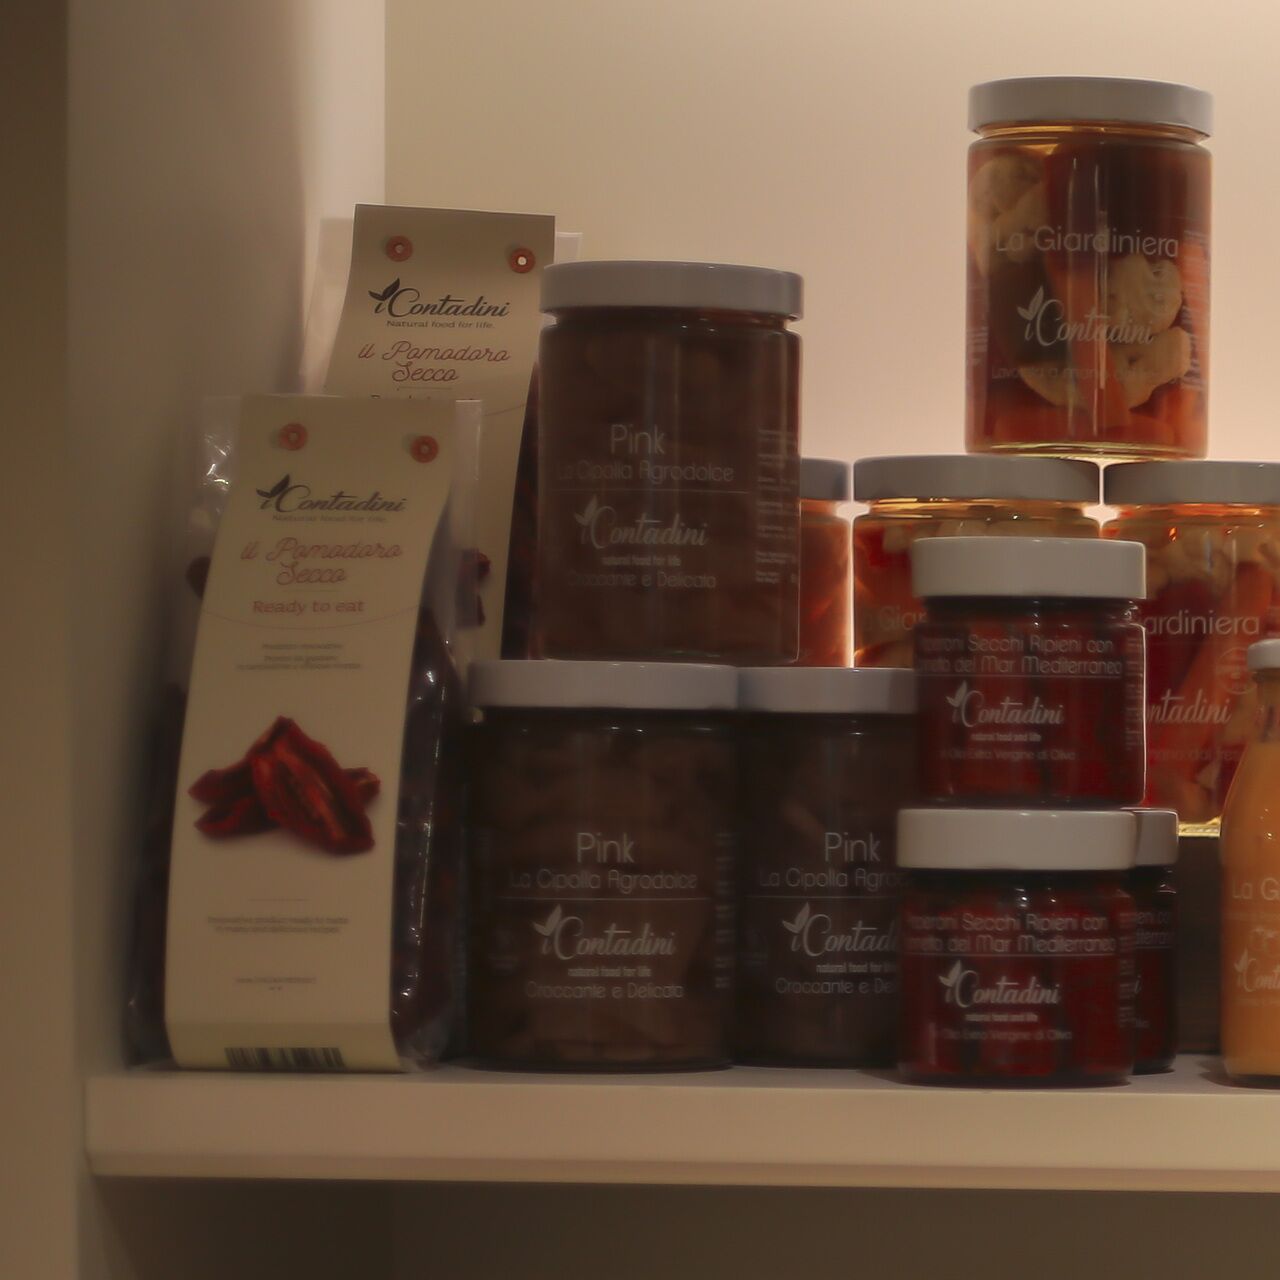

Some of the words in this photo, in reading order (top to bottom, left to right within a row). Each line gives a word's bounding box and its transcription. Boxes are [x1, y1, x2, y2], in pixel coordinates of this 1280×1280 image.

[996, 228, 1024, 252] La
[1034, 225, 1180, 258] Giardiniera
[610, 424, 666, 456] Pink
[312, 602, 332, 614] to
[335, 602, 365, 615] eat
[576, 831, 637, 865] Pink
[825, 831, 881, 864] Pink
